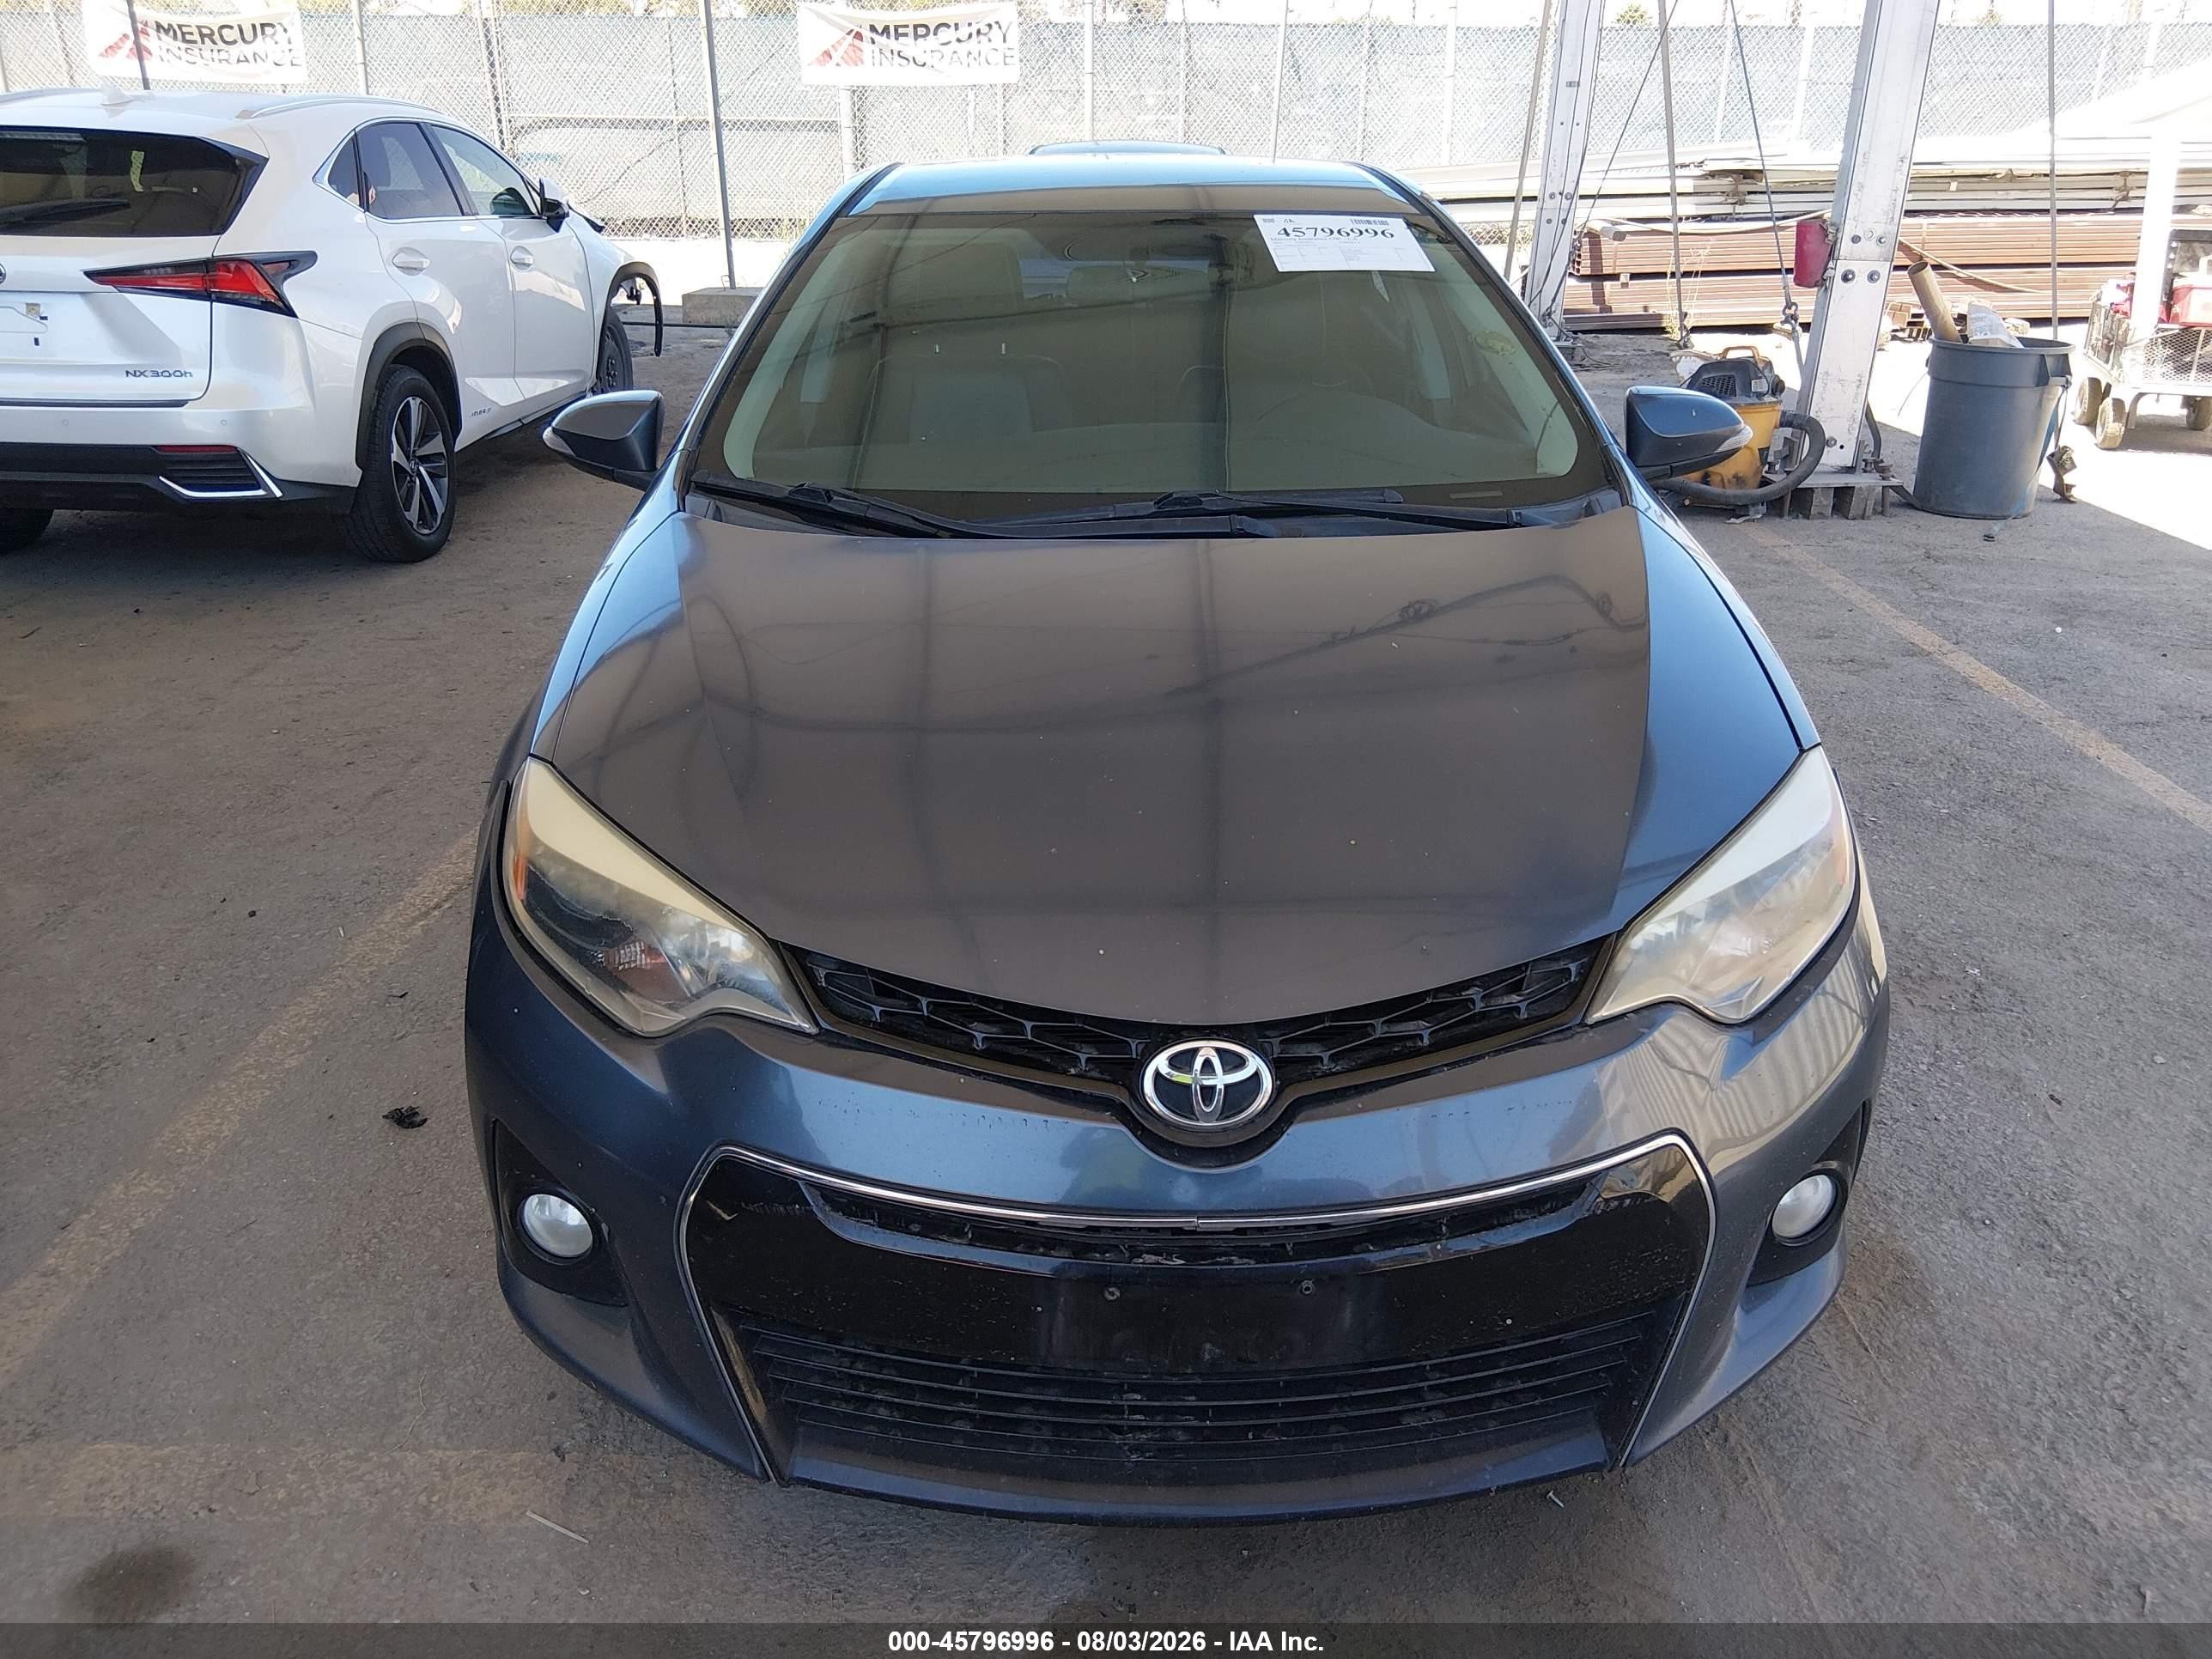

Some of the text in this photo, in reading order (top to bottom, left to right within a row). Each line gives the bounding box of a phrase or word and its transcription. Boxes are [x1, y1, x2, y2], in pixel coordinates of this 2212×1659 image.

[155, 20, 294, 46] MERCURY
[868, 21, 1013, 46] MERCURY
[1277, 227, 1395, 239] 45796996
[125, 369, 193, 379] NX300h
